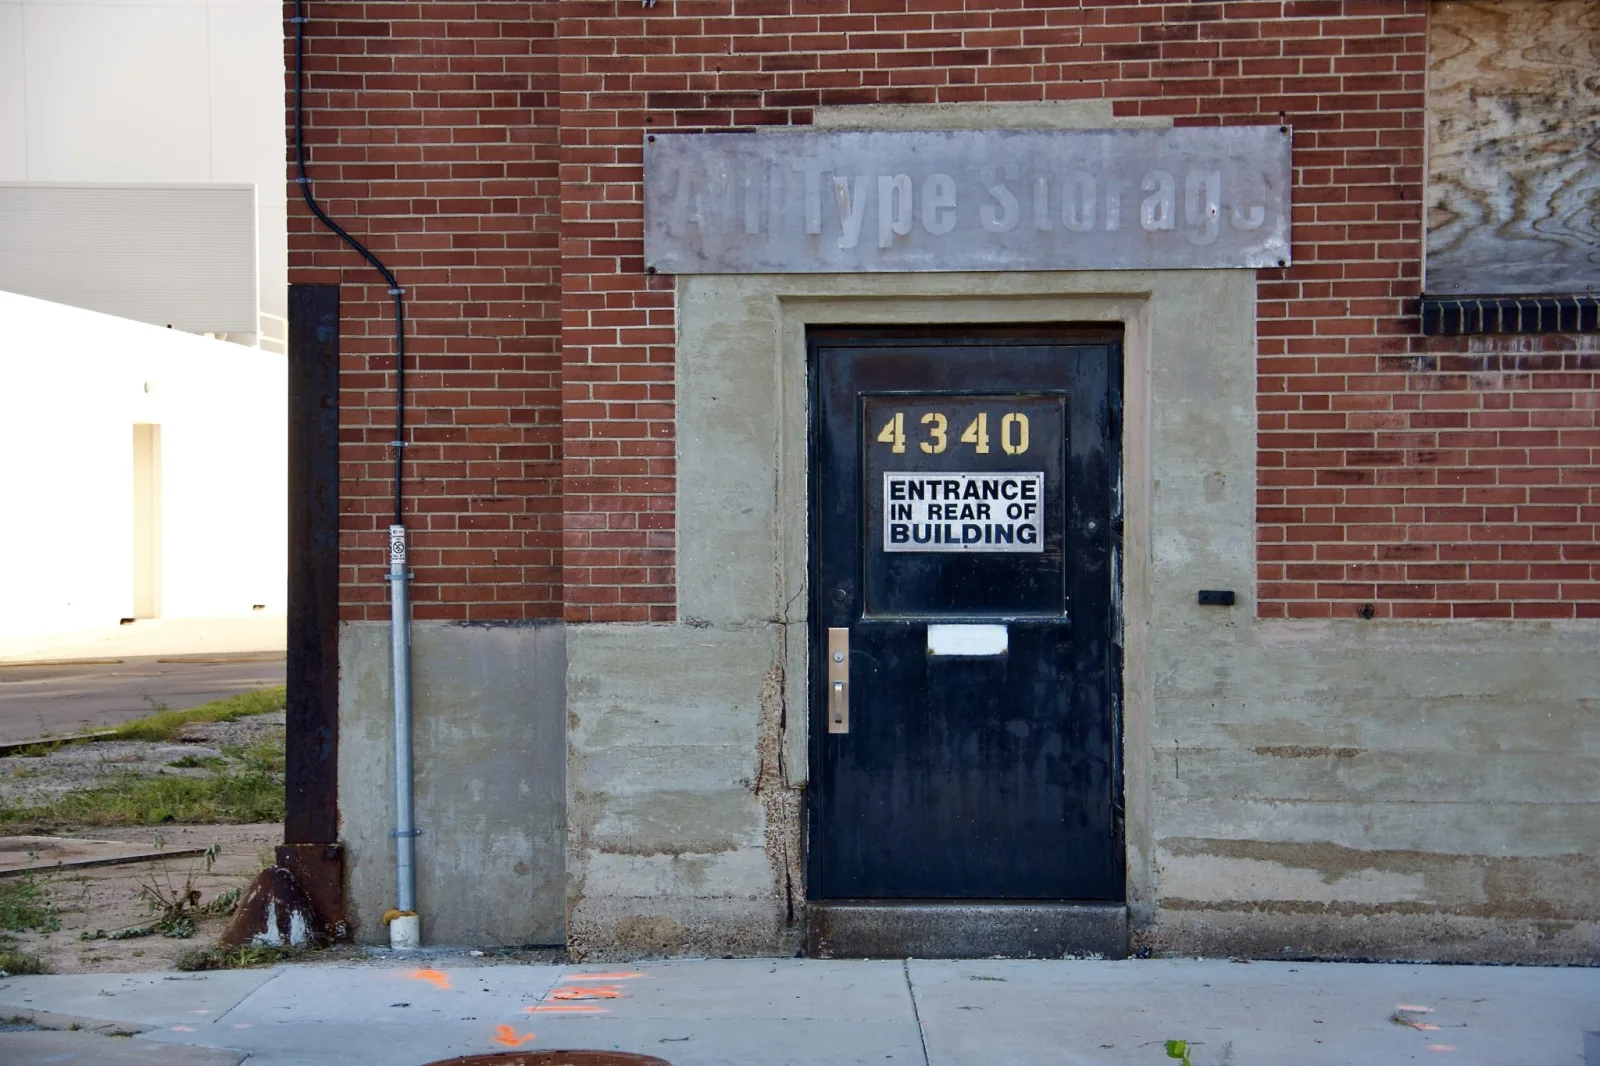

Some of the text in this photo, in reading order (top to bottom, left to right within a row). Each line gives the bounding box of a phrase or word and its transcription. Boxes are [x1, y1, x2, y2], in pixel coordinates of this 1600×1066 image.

[791, 156, 957, 249] Type
[979, 163, 1267, 246] Storage
[877, 412, 1030, 454] 4340
[890, 480, 1037, 500] ENTRANCE
[890, 503, 1037, 521] IN REAR OF
[890, 523, 1037, 544] BUILDING
